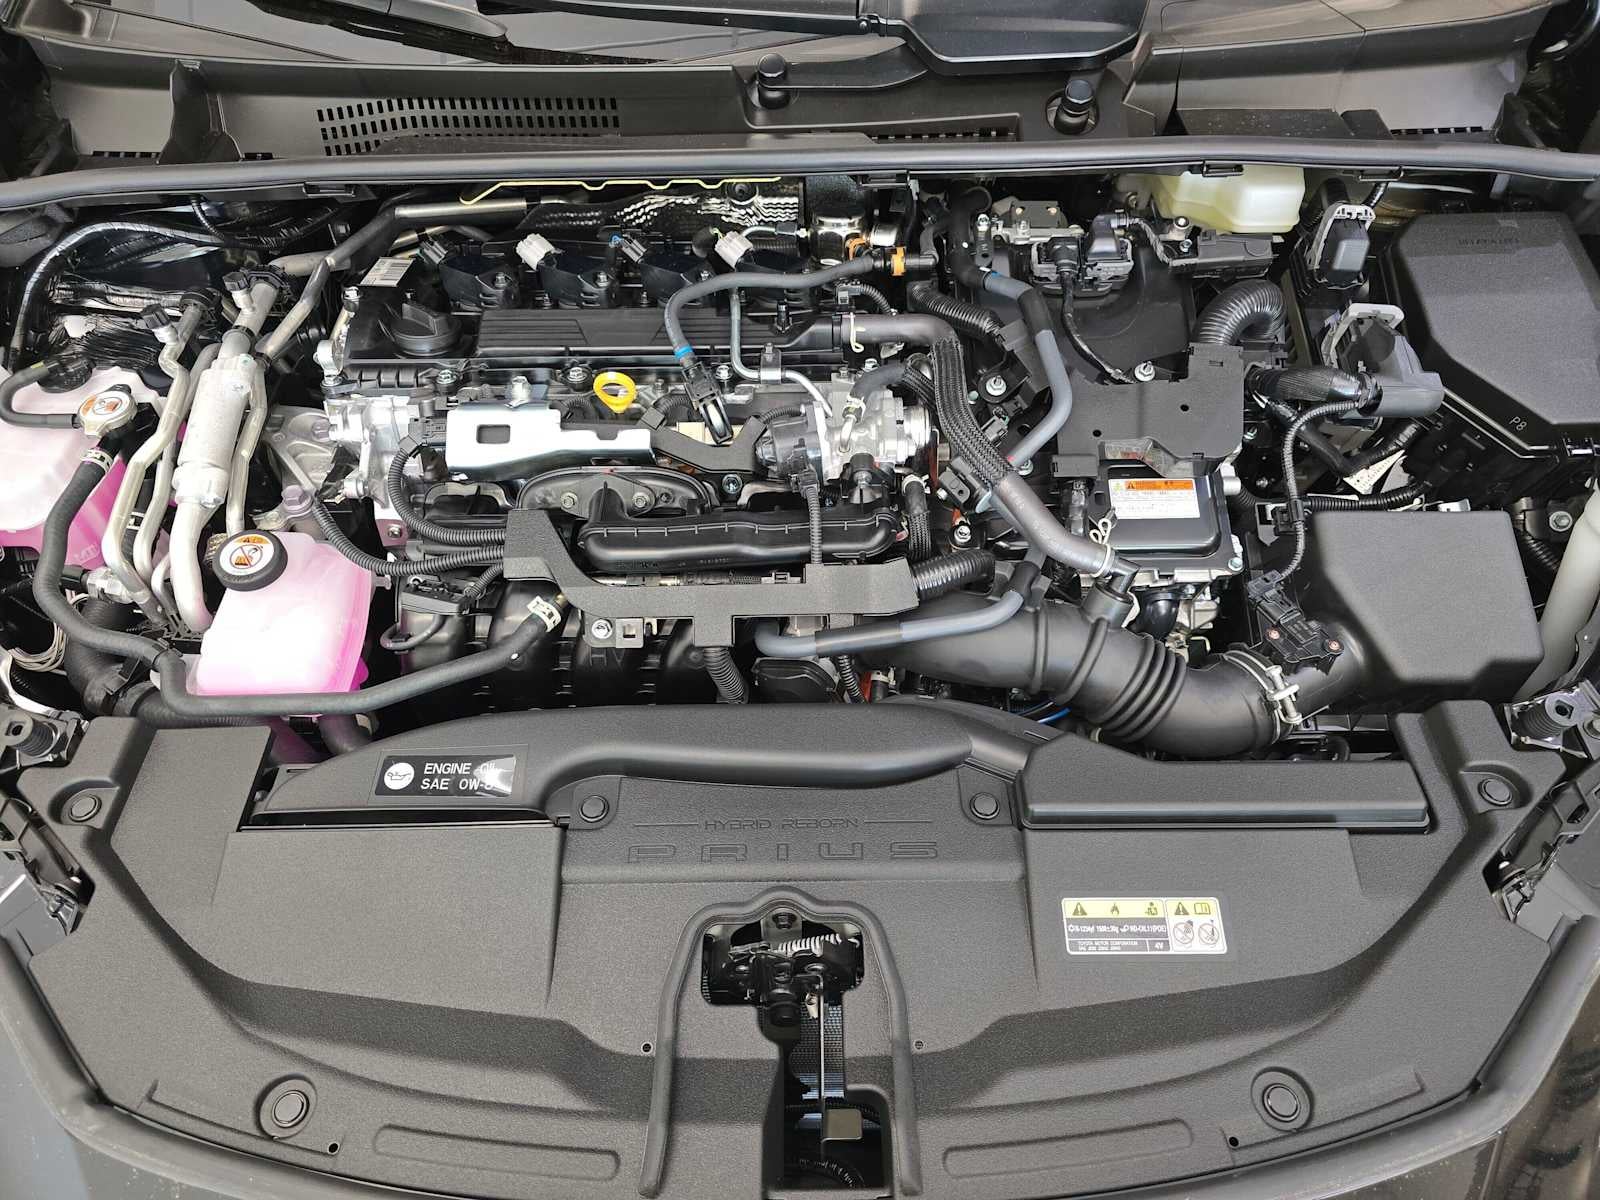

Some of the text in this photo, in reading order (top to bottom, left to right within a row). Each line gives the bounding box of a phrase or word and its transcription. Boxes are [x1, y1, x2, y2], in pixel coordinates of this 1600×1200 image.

[1508, 416, 1527, 431] P8
[423, 762, 472, 775] ENGINE
[420, 778, 451, 790] SAE
[704, 817, 859, 831] HYBRID REBORN
[628, 841, 938, 864] PRIUS
